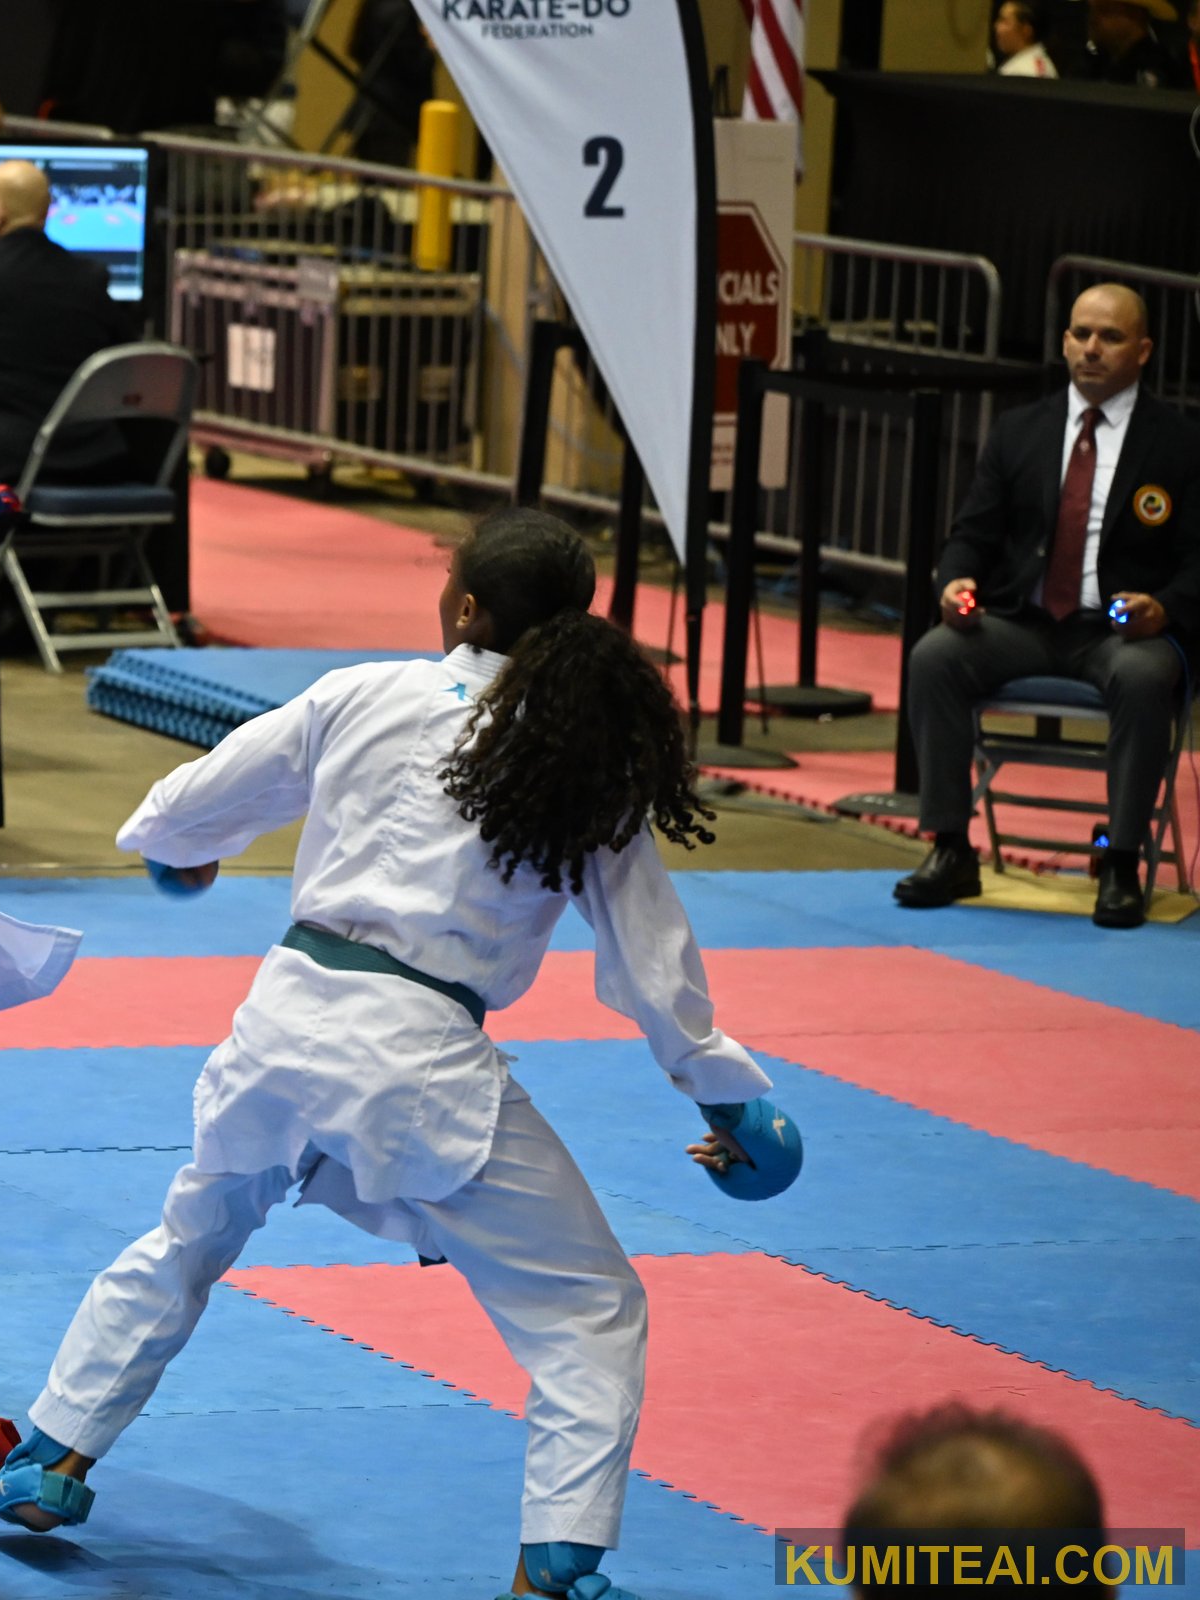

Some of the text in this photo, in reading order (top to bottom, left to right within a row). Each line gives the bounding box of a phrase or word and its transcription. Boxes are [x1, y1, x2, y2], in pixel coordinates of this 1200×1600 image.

[442, 0, 631, 20] KARATE-DO
[481, 22, 594, 39] FEDERATION
[582, 135, 625, 218] 2
[715, 321, 757, 356] NLY
